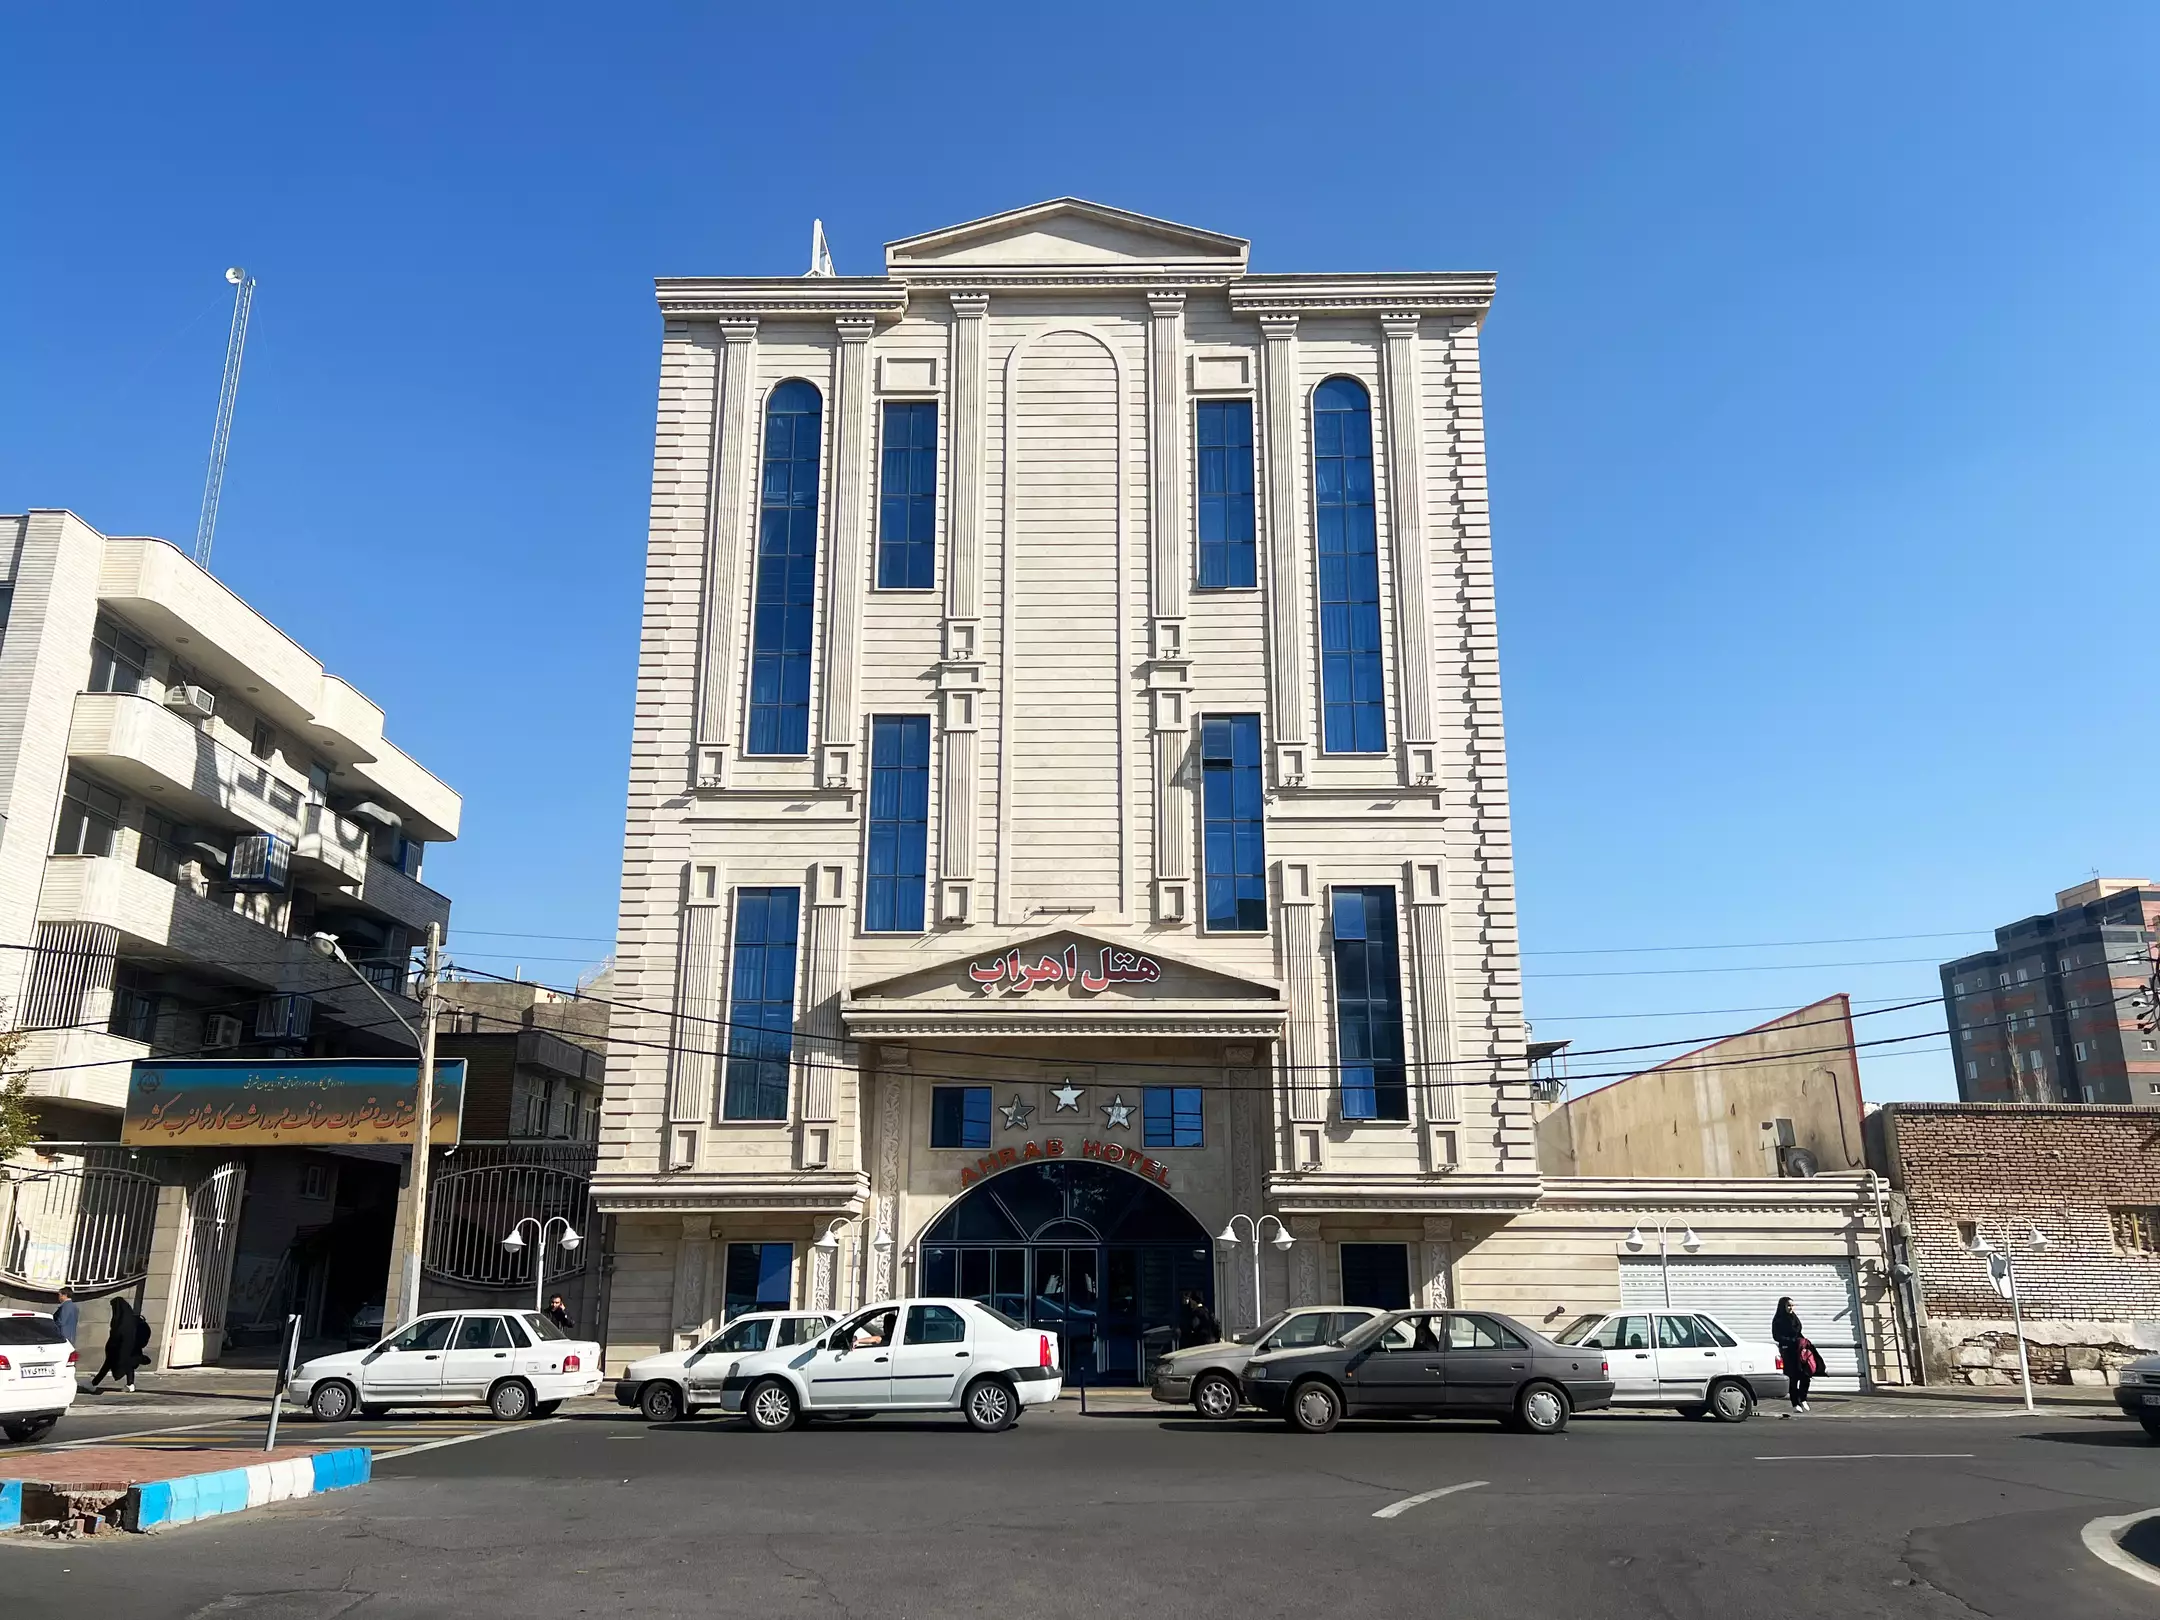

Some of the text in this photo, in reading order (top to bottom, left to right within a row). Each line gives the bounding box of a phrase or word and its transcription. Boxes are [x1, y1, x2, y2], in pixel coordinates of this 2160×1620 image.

[968, 943, 1161, 993] هتل اهراب
[960, 1138, 1171, 1189] AHRAB HOTEL
